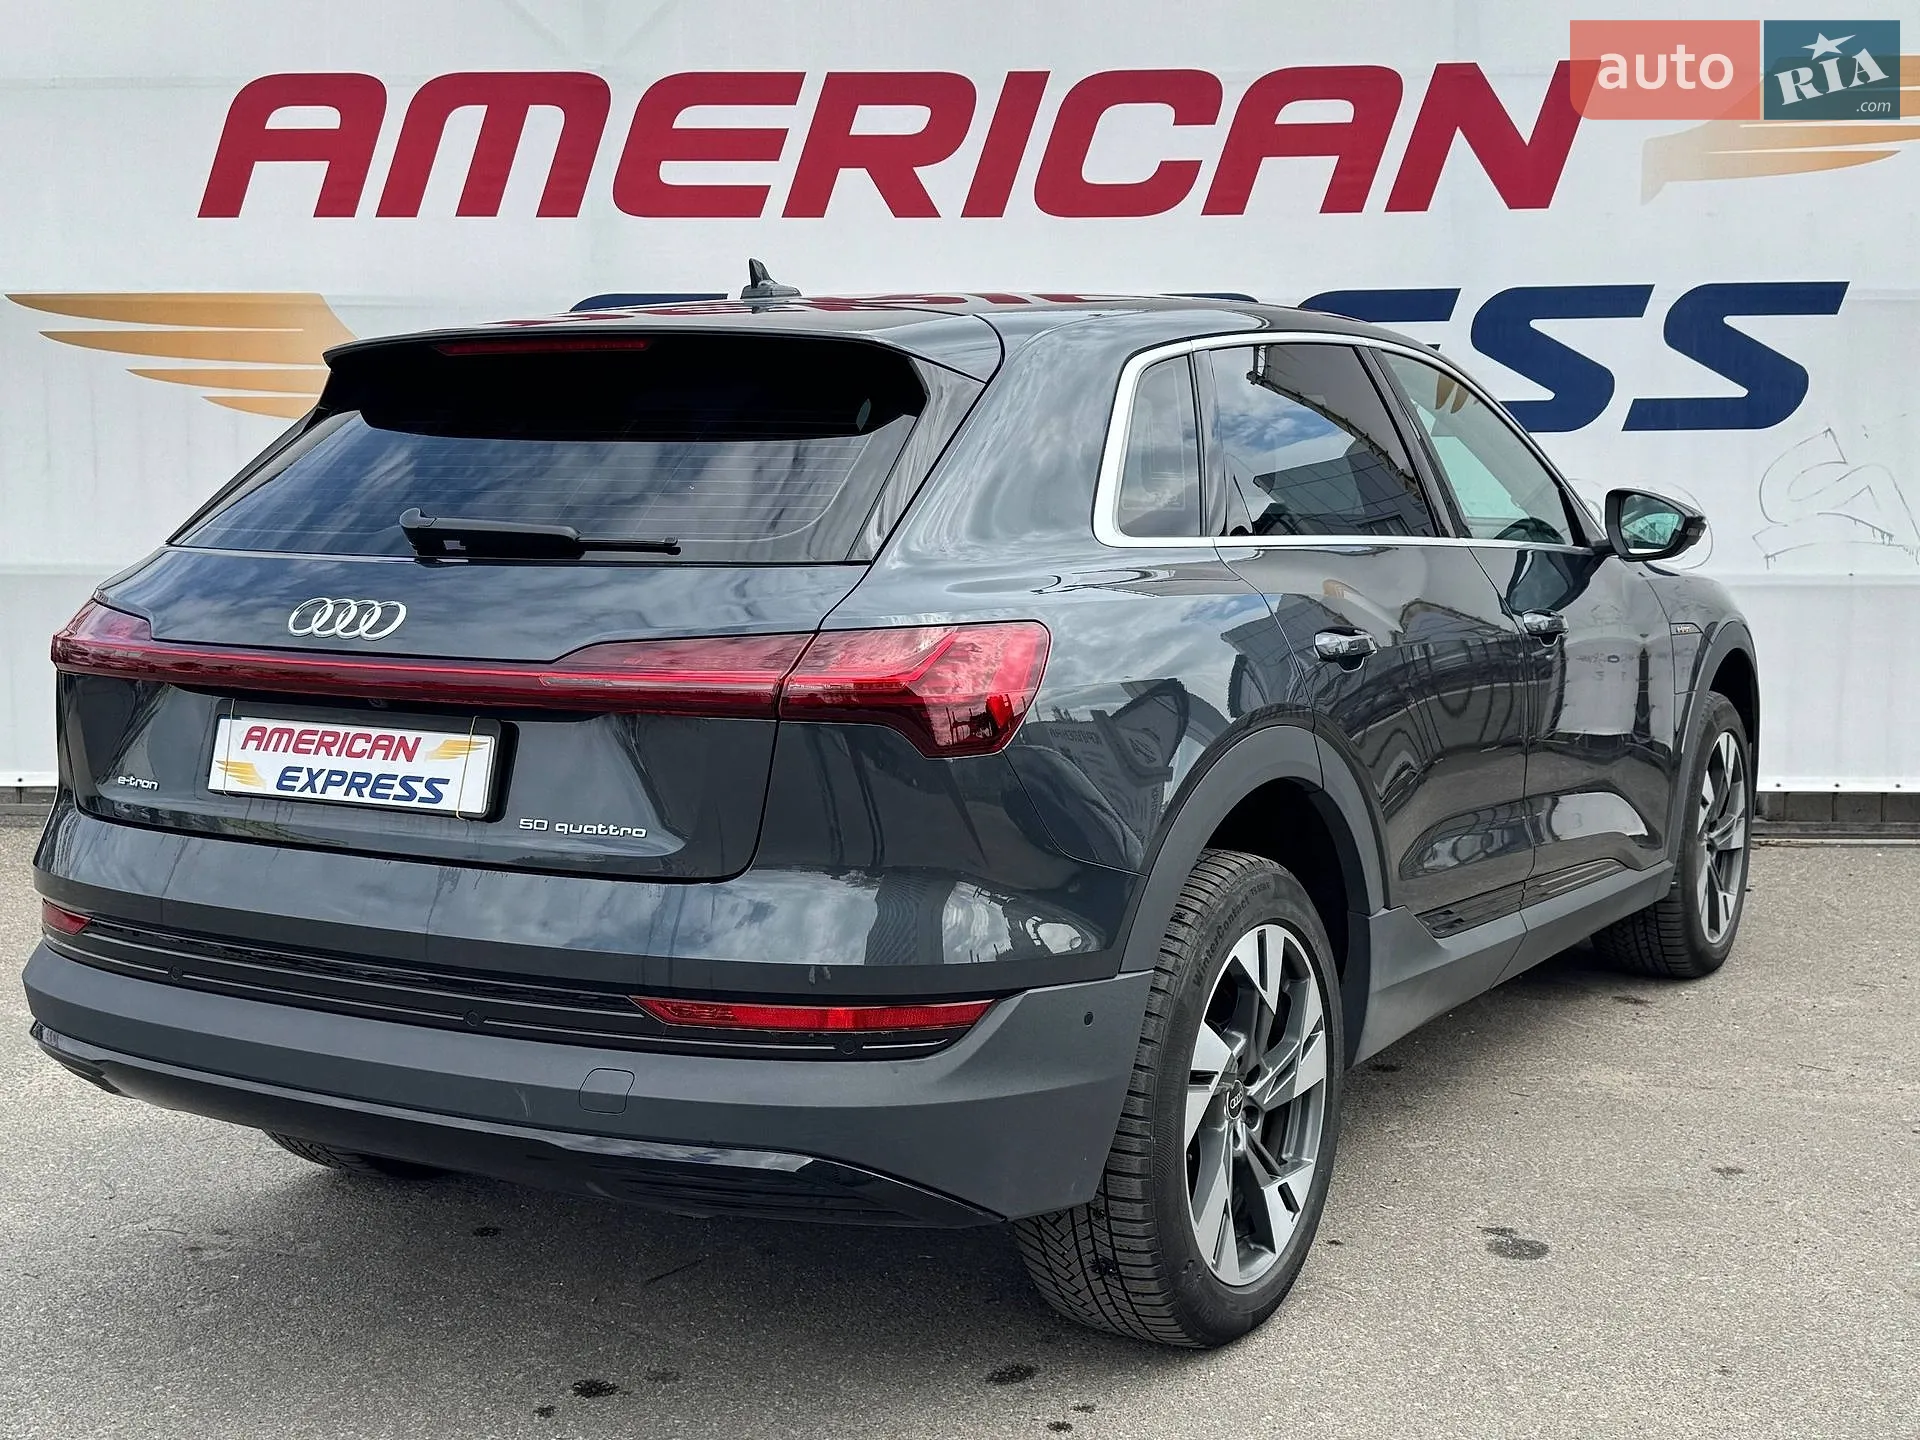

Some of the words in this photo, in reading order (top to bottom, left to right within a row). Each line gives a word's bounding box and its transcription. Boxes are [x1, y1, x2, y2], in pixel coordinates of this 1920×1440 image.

[196, 60, 1600, 218] AMERICAN
[240, 725, 422, 763] AMERICAN
[117, 775, 159, 790] e-tron
[275, 765, 450, 805] EXPRESS
[518, 817, 549, 831] 50
[555, 823, 647, 838] quattro
